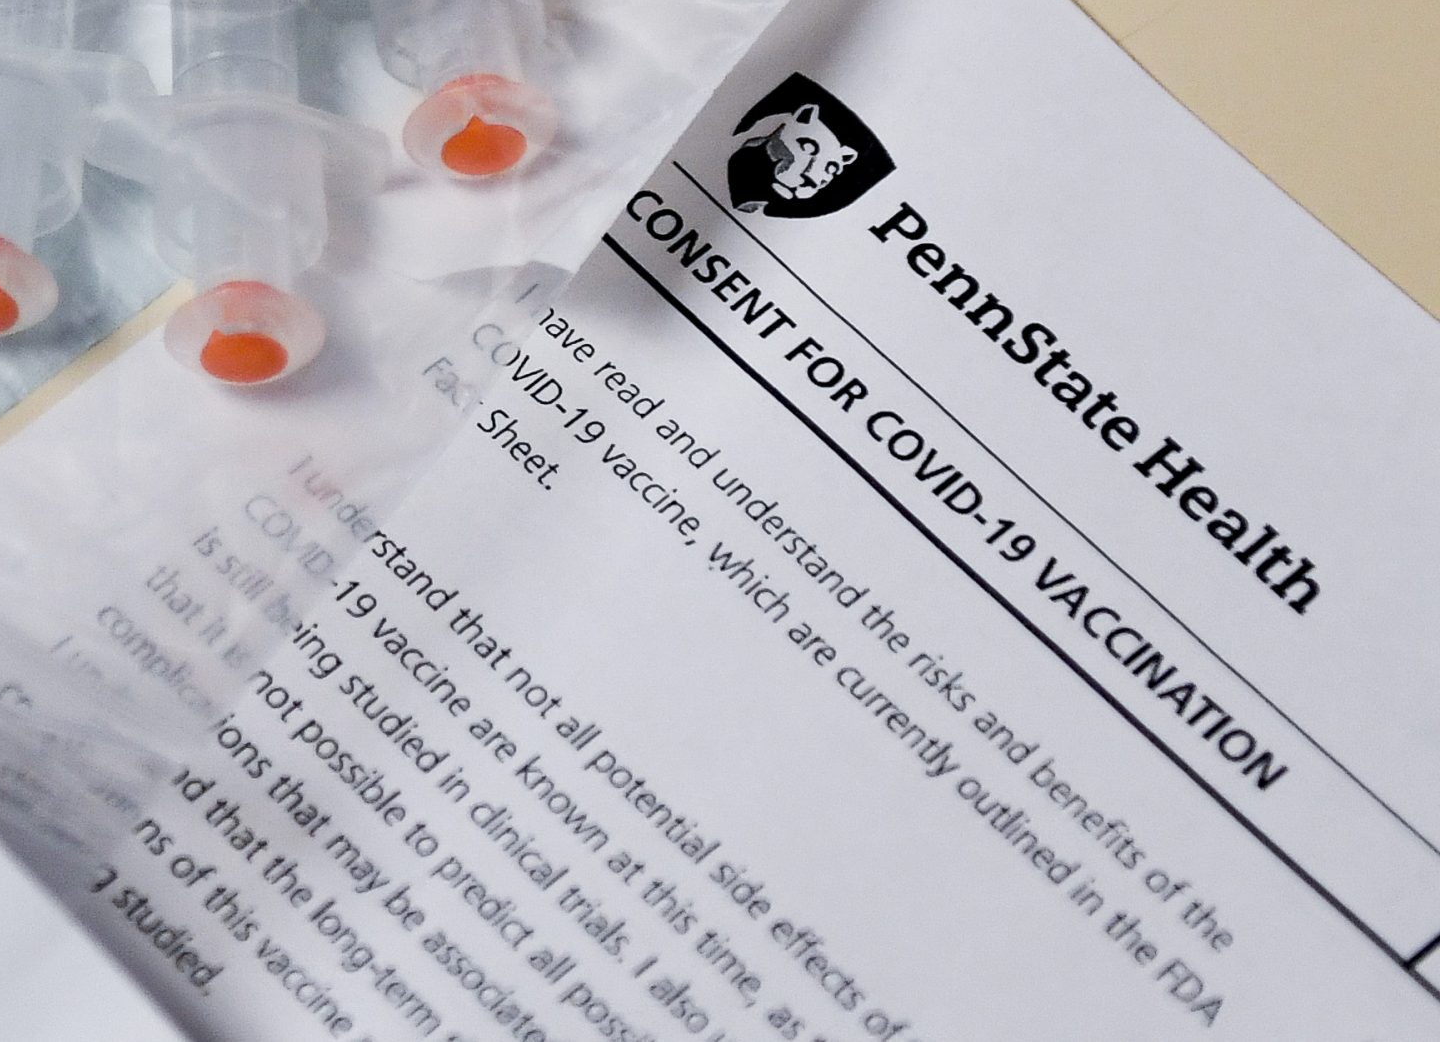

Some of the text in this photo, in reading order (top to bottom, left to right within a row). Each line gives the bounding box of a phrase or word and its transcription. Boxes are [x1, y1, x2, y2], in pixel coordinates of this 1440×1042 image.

[476, 409, 560, 491] Sheet.
[625, 189, 1289, 792] CONSENT FOR COVID-19 VACCINATION
[1132, 436, 1321, 616] Health
[302, 471, 460, 613] understand
[449, 608, 513, 671] that
[504, 666, 562, 720] not
[555, 716, 603, 752] all
[583, 749, 722, 865] potential
[708, 862, 772, 920] side
[769, 919, 866, 1012] effects
[862, 1011, 911, 1042] of
[593, 361, 666, 420] read
[655, 419, 722, 470] and
[712, 467, 871, 609] understand
[860, 604, 910, 654] the
[907, 652, 977, 713] risks
[972, 711, 1041, 766] and
[1027, 758, 1146, 870] benefits
[1143, 868, 1193, 903] of
[1180, 899, 1234, 951] the
[601, 443, 700, 547] vaccine,
[708, 541, 790, 624] which
[787, 622, 837, 667] are
[836, 666, 961, 778] currently
[955, 776, 1082, 886] outlined
[1069, 878, 1105, 917] in
[1104, 911, 1158, 966] the
[1156, 957, 1224, 1028] FDA
[169, 854, 353, 1033] of this vaccine
[204, 798, 269, 862] that
[262, 855, 313, 906] the
[307, 897, 442, 1038] long-term
[249, 669, 304, 724] not
[289, 718, 407, 827] possible
[403, 821, 439, 858] to
[429, 855, 535, 952] predict
[527, 949, 577, 985] all
[267, 775, 332, 838] that
[324, 832, 390, 894] may
[382, 884, 425, 932] be
[338, 674, 451, 774] studied
[437, 766, 471, 804] in
[469, 802, 570, 892] clinical
[558, 886, 630, 964] trials.
[633, 956, 659, 979] I
[648, 978, 710, 1034] also
[372, 616, 471, 717] vaccine
[468, 717, 517, 762] are
[514, 754, 610, 853] known
[606, 851, 645, 884] at
[641, 879, 698, 935] this
[695, 929, 762, 1009] time,
[767, 1007, 803, 1040] as
